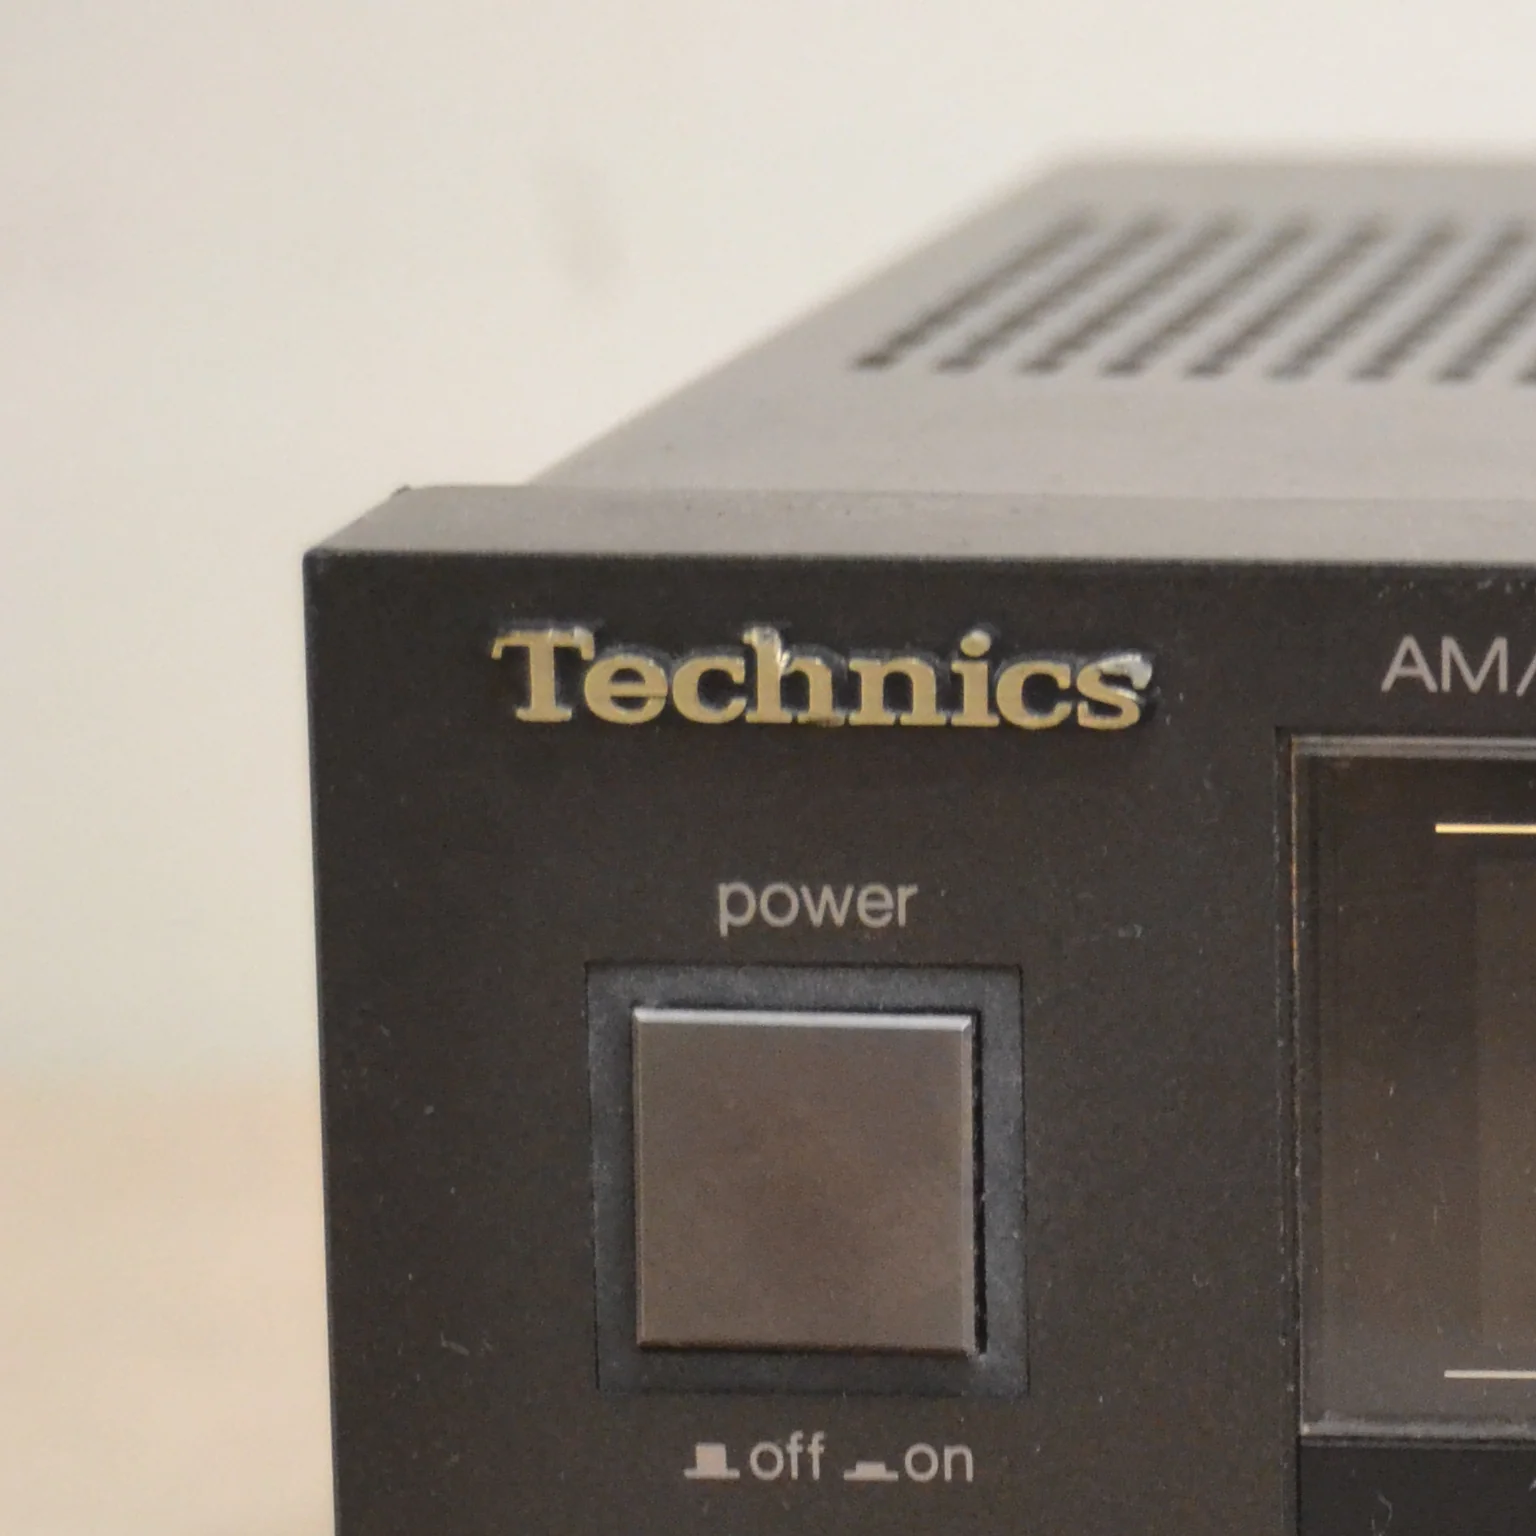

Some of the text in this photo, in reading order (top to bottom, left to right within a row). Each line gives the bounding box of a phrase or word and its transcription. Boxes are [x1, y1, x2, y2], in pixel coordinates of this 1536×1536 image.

[491, 625, 1156, 730] Technics
[718, 880, 919, 936] power
[748, 1431, 976, 1483] off on
